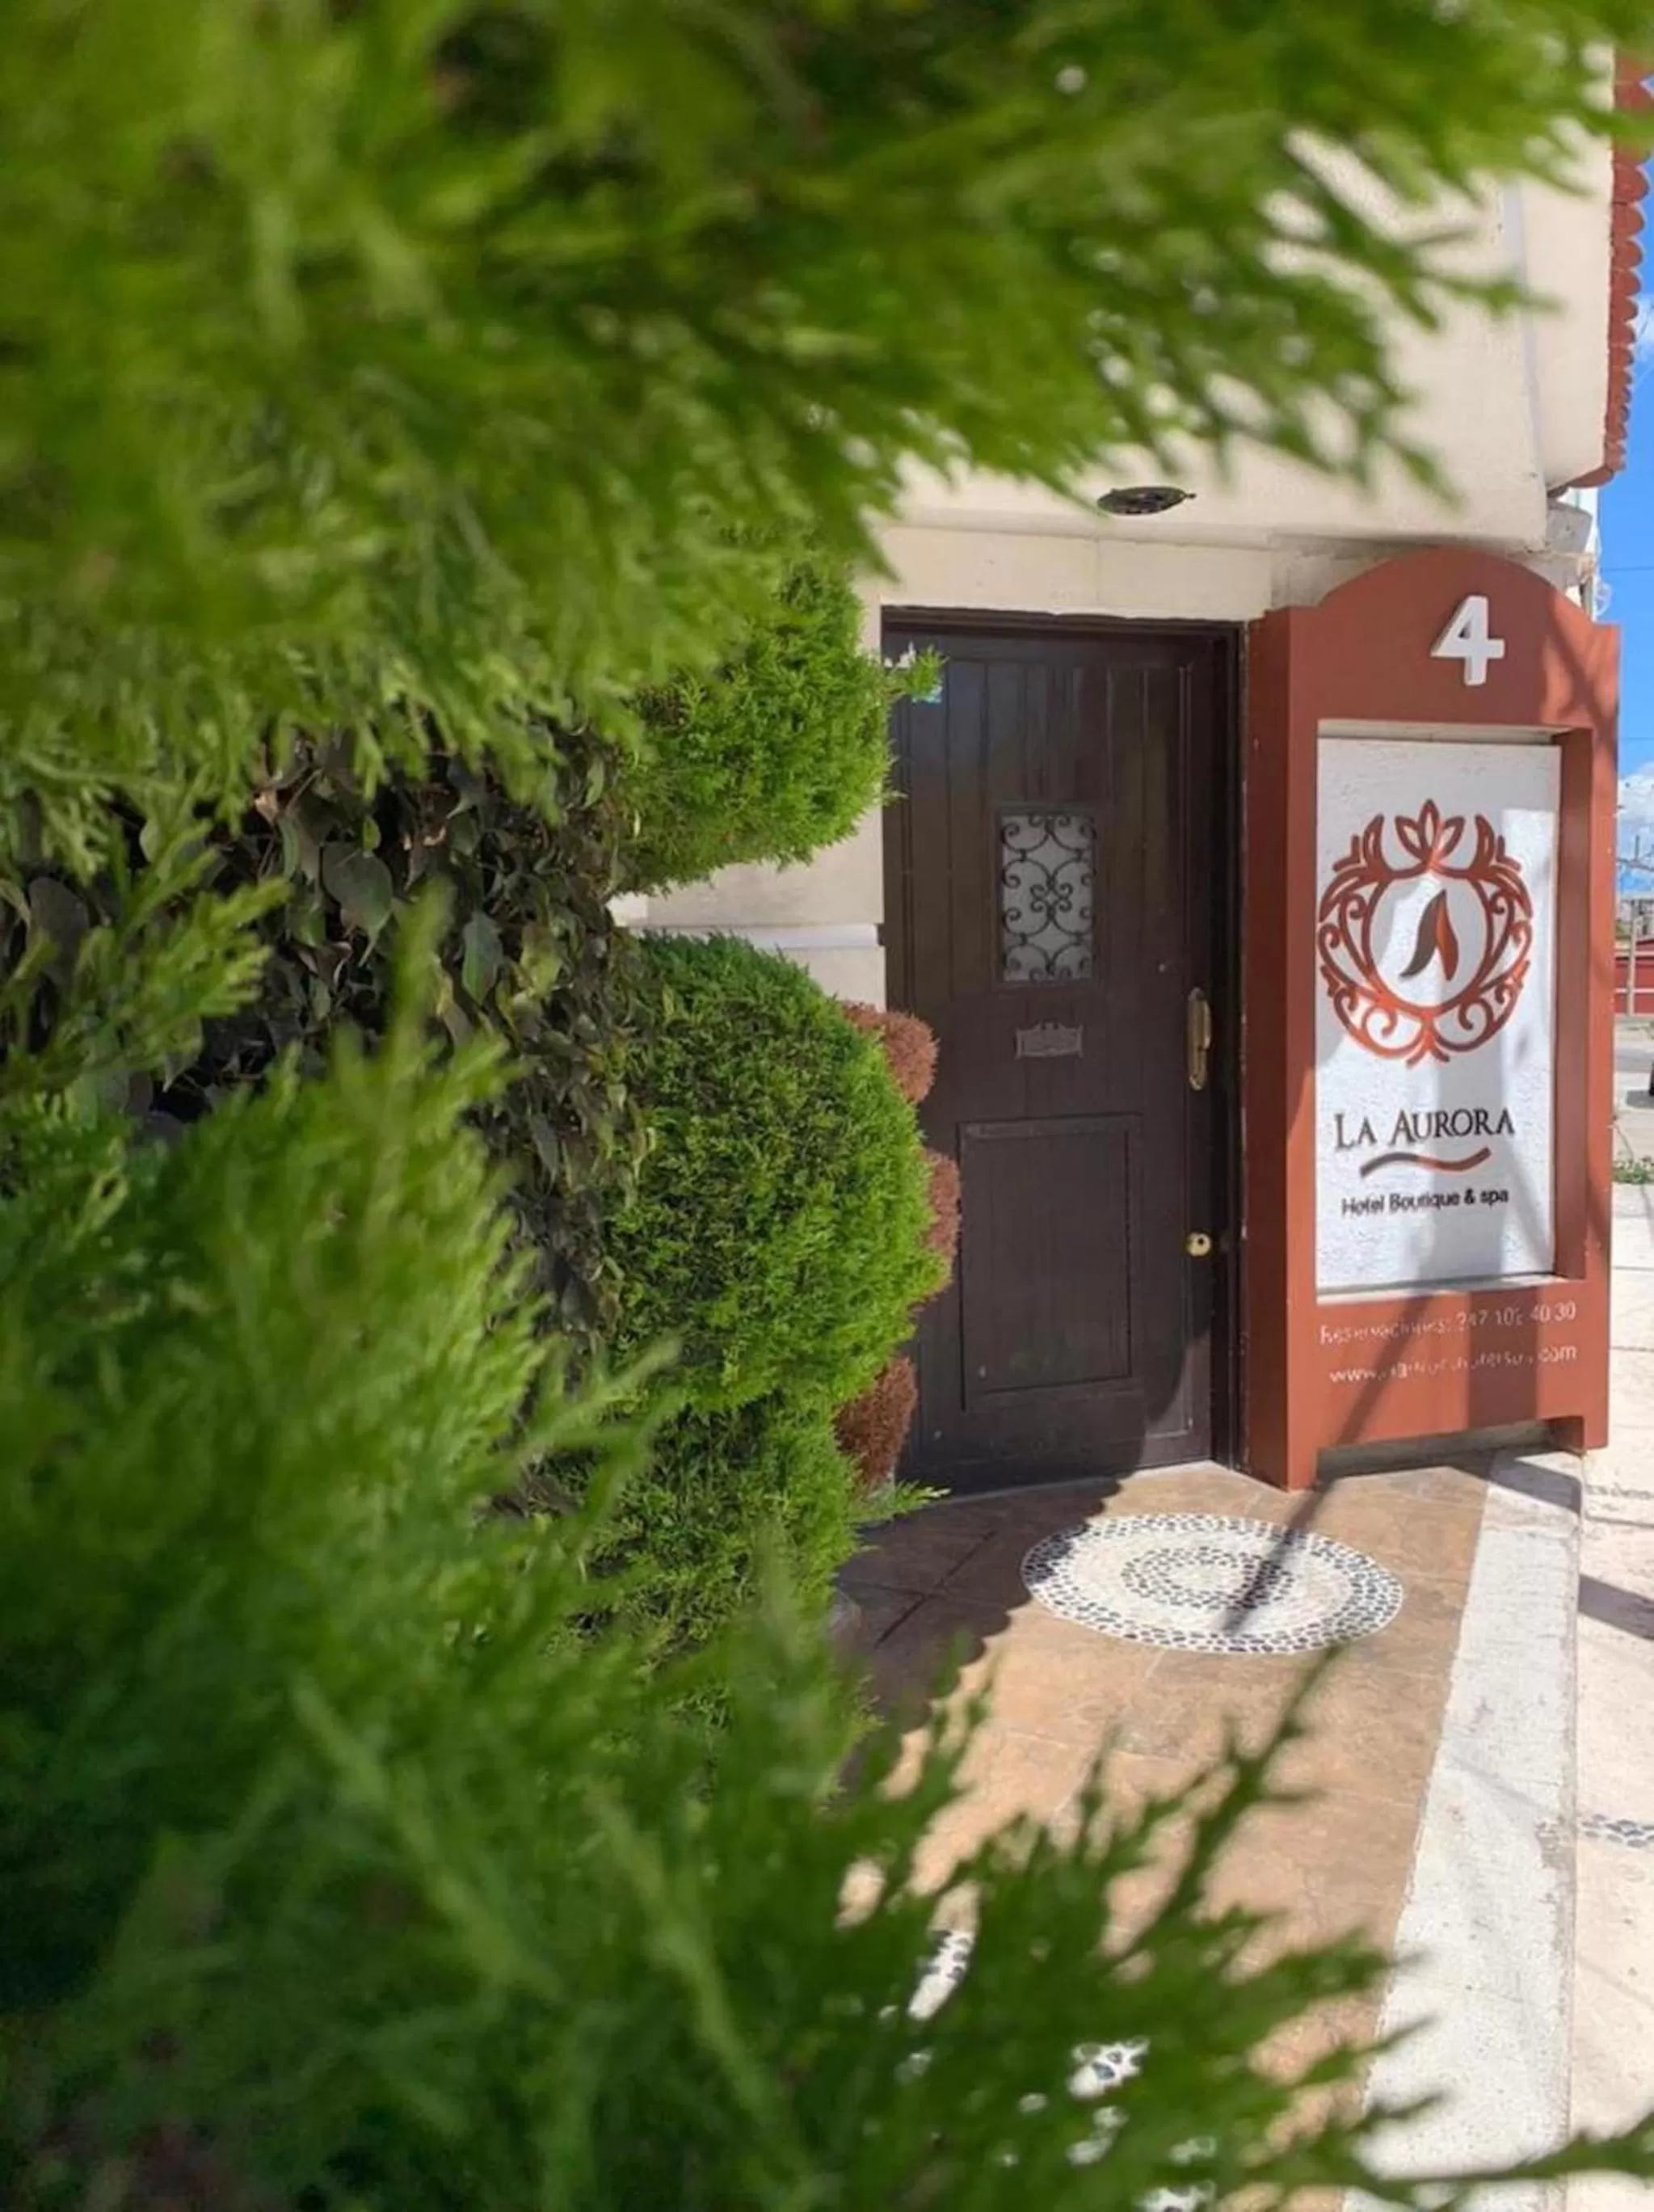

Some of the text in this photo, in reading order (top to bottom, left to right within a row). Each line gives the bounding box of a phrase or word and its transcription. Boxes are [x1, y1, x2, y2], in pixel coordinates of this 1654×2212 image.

[1429, 595, 1505, 687] 4
[1334, 1106, 1516, 1152] LA AURORA
[1341, 1188, 1509, 1218] Hotel Boutique & spa
[1554, 1300, 1577, 1321] 30
